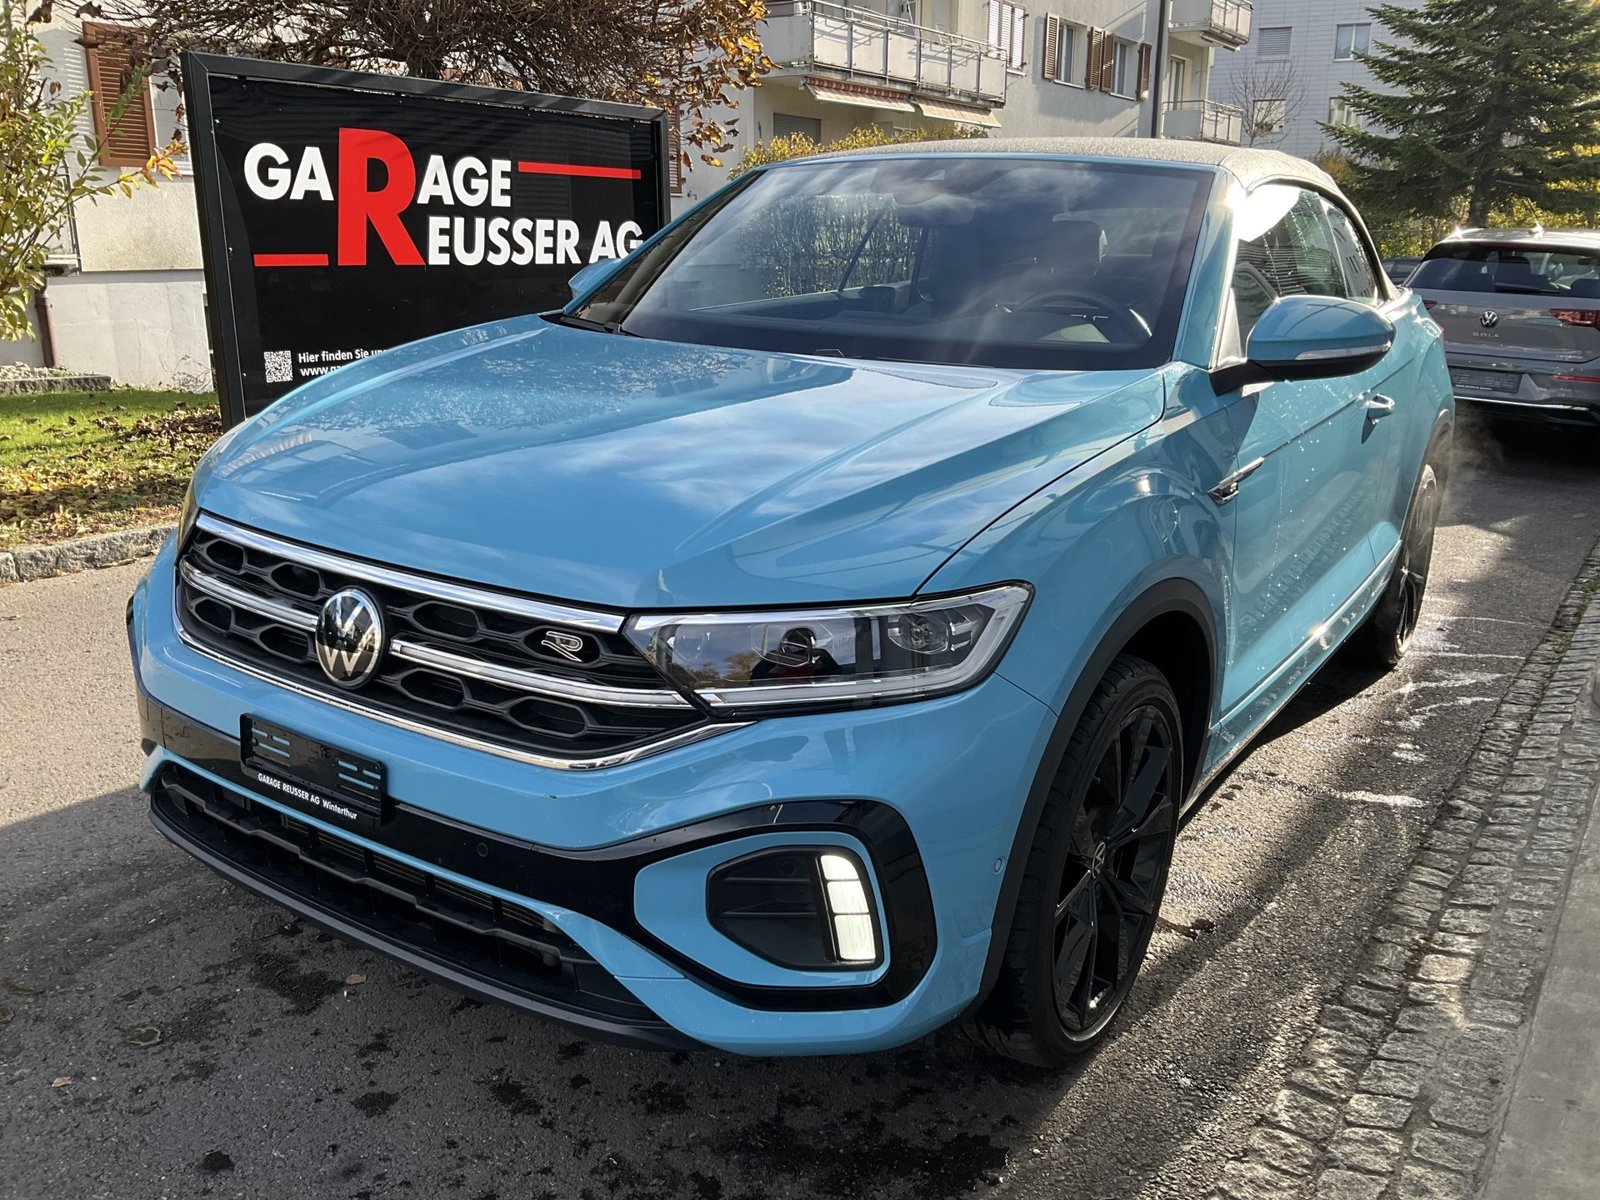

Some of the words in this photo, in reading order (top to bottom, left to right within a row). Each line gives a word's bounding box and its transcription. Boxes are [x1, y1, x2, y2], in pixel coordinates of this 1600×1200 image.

[244, 127, 512, 266] GARAGE
[588, 220, 644, 264] AG
[298, 352, 319, 363] Hier
[321, 350, 353, 362] finden
[355, 348, 369, 359] Sie
[258, 773, 281, 790] GARAGE
[282, 783, 309, 800] REUSSER
[310, 794, 320, 805] AG
[322, 799, 357, 819] Winterthur
